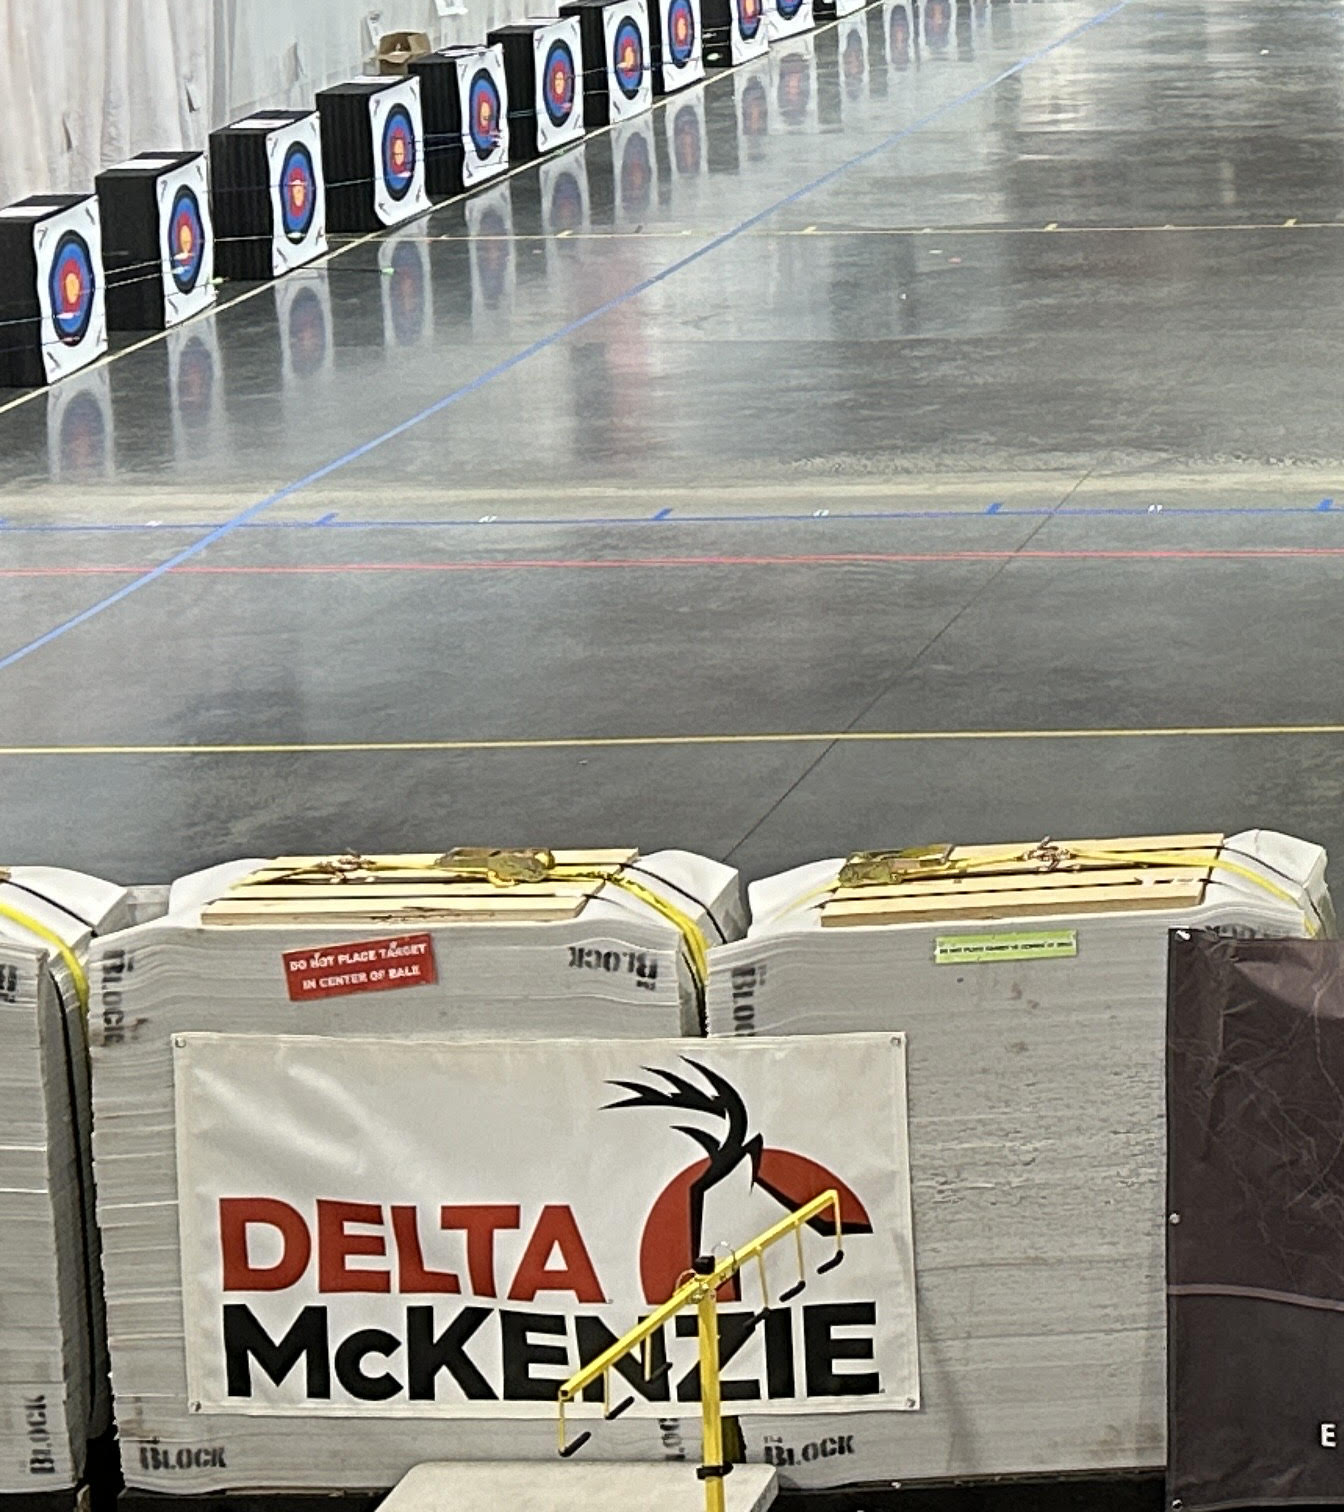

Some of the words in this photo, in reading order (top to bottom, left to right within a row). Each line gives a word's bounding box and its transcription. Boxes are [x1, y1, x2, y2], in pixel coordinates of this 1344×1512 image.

[289, 960, 307, 971] DO
[337, 950, 377, 965] PLACE
[379, 943, 427, 959] TARGET
[567, 946, 658, 979] BLOCK
[302, 979, 316, 990] IN
[319, 973, 368, 988] CENTER
[370, 970, 385, 981] OF
[388, 965, 421, 978] BALE
[219, 1197, 611, 1305] DELTA
[221, 1301, 882, 1404] McKENZIE
[24, 1394, 56, 1475] BLOCK
[139, 1445, 227, 1471] BLOCK
[764, 1435, 855, 1467] BLOCK
